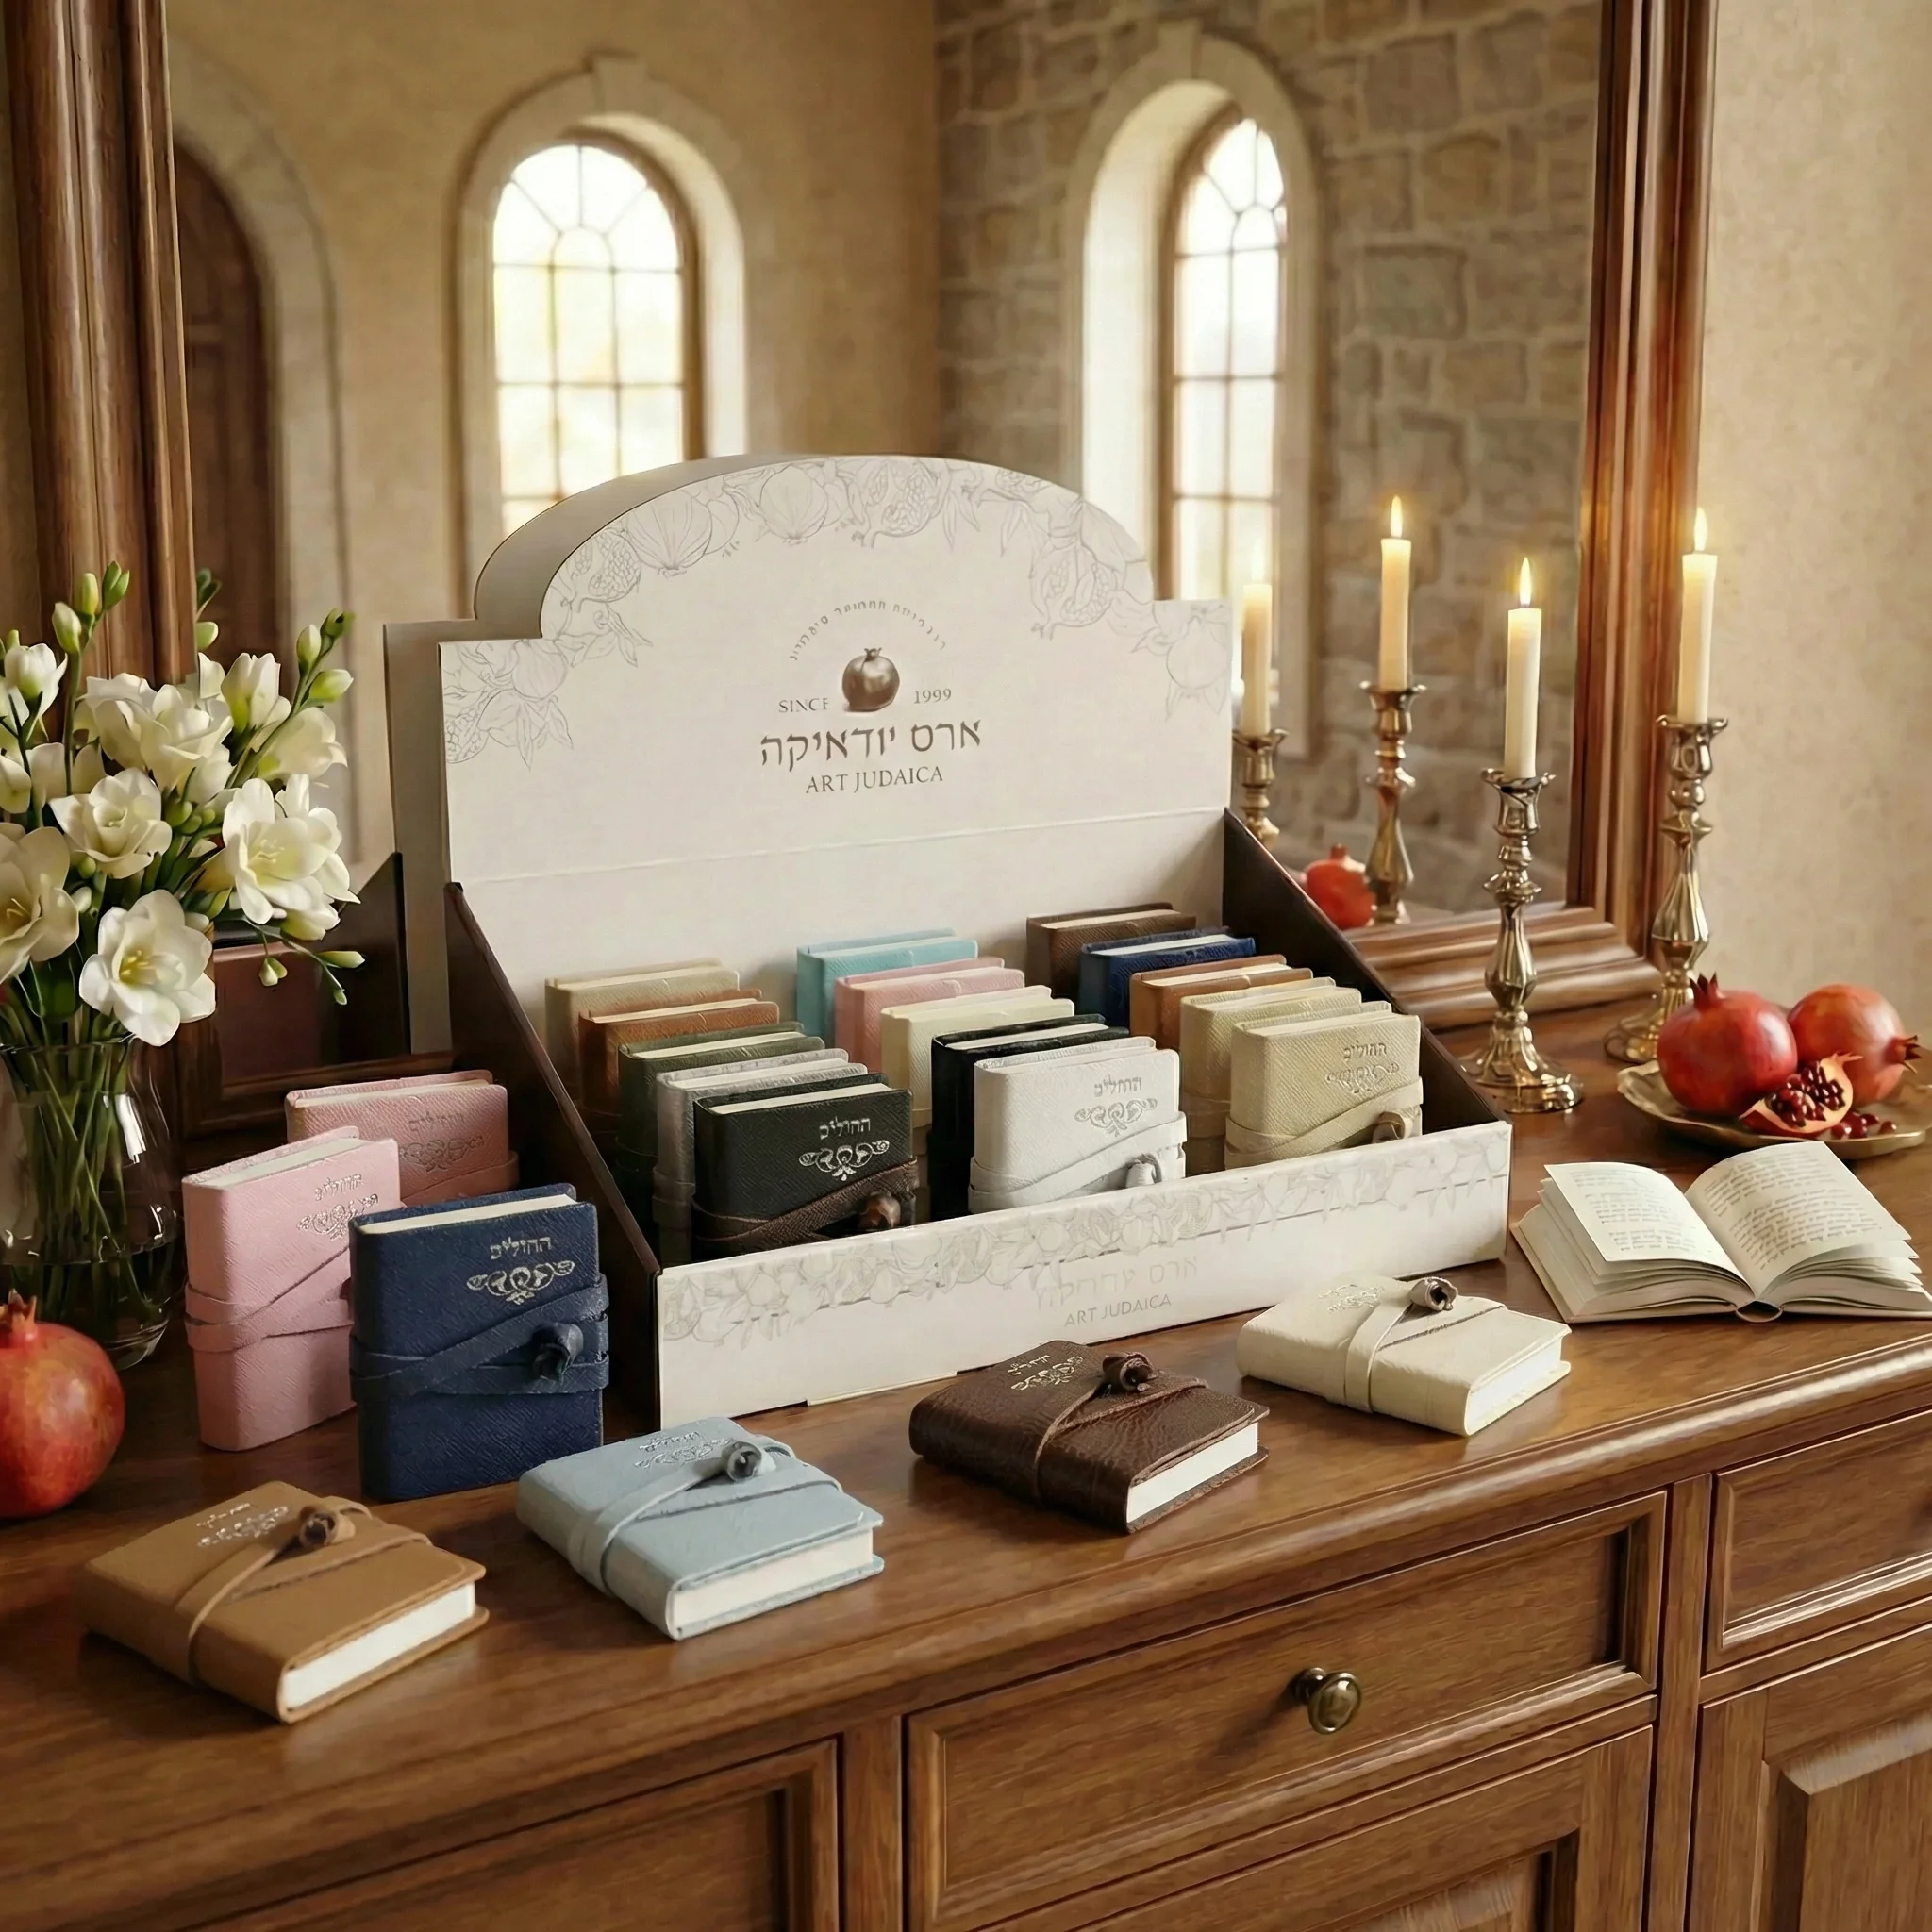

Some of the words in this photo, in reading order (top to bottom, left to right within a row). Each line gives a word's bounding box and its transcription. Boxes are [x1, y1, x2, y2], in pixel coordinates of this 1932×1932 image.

[913, 688, 952, 704] 1999
[760, 725, 896, 772] יודאיקה
[910, 719, 981, 752] ארס
[806, 774, 849, 793] ART
[853, 765, 943, 793] JUDAICA
[1064, 1307, 1097, 1326] ART
[1101, 1294, 1172, 1319] JUDAICA
